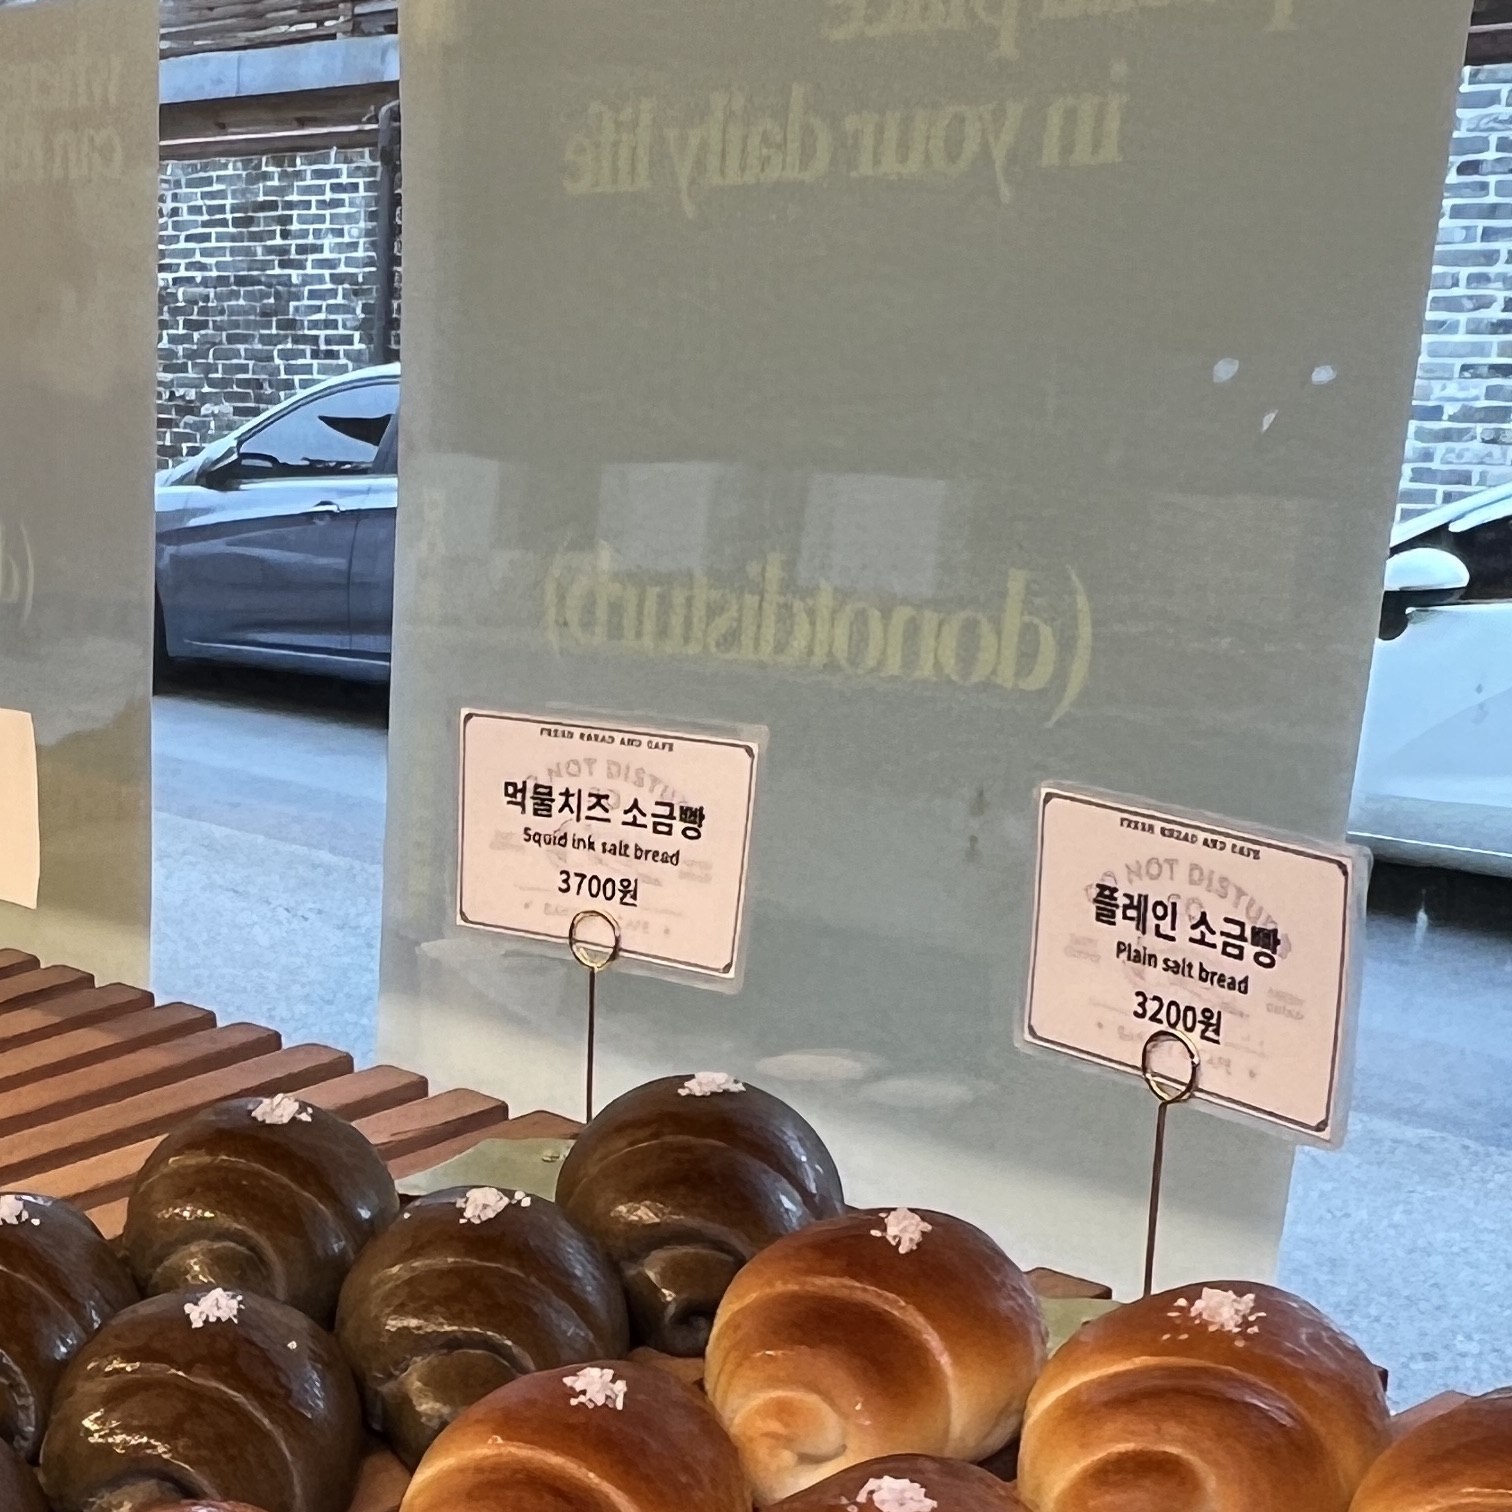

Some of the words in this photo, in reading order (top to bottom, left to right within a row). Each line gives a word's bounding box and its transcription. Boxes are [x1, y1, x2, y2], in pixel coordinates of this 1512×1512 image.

[504, 780, 612, 823] 먹물치즈
[621, 797, 706, 841] 소금빵
[523, 826, 568, 848] Squid
[571, 833, 596, 852] ink
[601, 839, 630, 858] salt
[634, 844, 680, 867] bread
[557, 869, 639, 908] 3700원
[1092, 882, 1178, 942] 플레인
[1188, 911, 1281, 970] 소금빵
[1115, 940, 1158, 970] Plain
[1162, 953, 1194, 979] salt
[1198, 961, 1249, 995] bread
[1133, 990, 1223, 1044] 3200원
